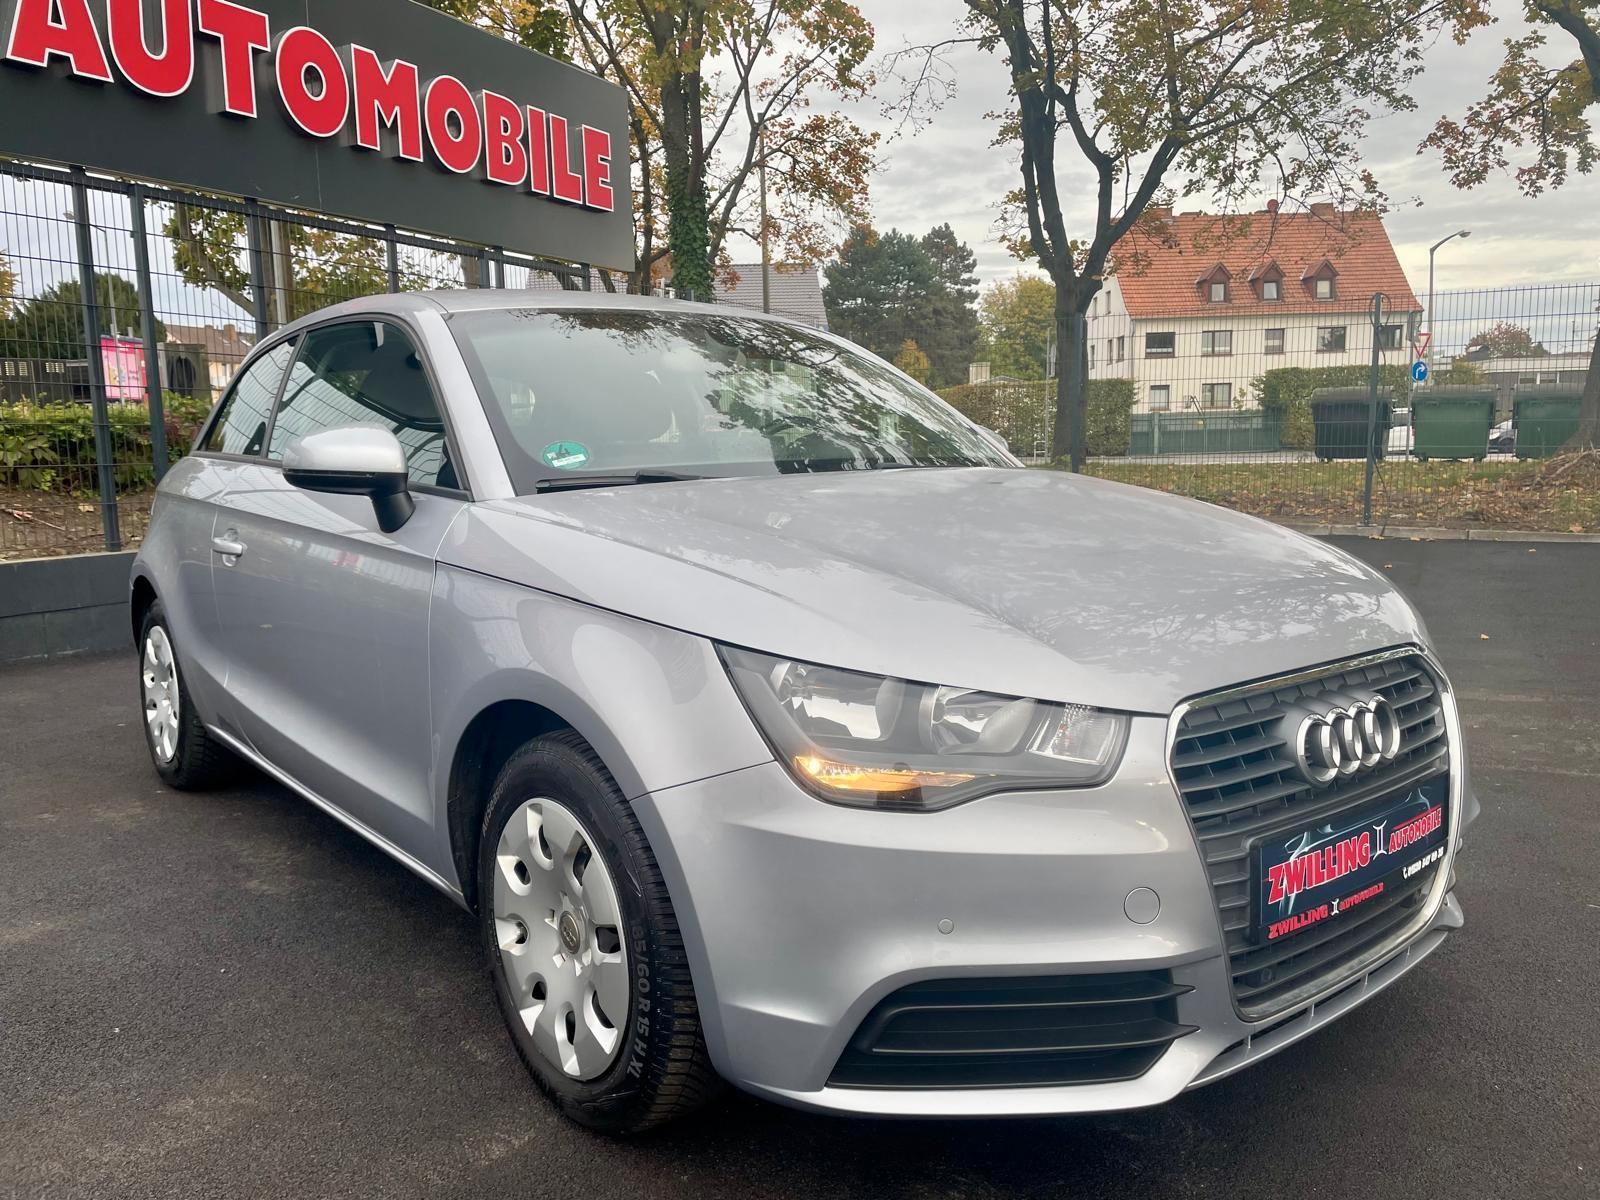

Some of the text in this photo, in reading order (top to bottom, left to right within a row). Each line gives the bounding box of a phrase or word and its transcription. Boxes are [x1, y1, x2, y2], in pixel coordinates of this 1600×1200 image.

[4, 0, 614, 213] AUTOMOBILE
[1268, 832, 1370, 904] ZWILLING
[1388, 808, 1442, 854] AUTOMOBILE
[1268, 904, 1328, 939] ZWILLING
[638, 997, 651, 1012] R
[637, 1016, 650, 1036] 15
[633, 1038, 647, 1056] H
[626, 1054, 643, 1078] XL
